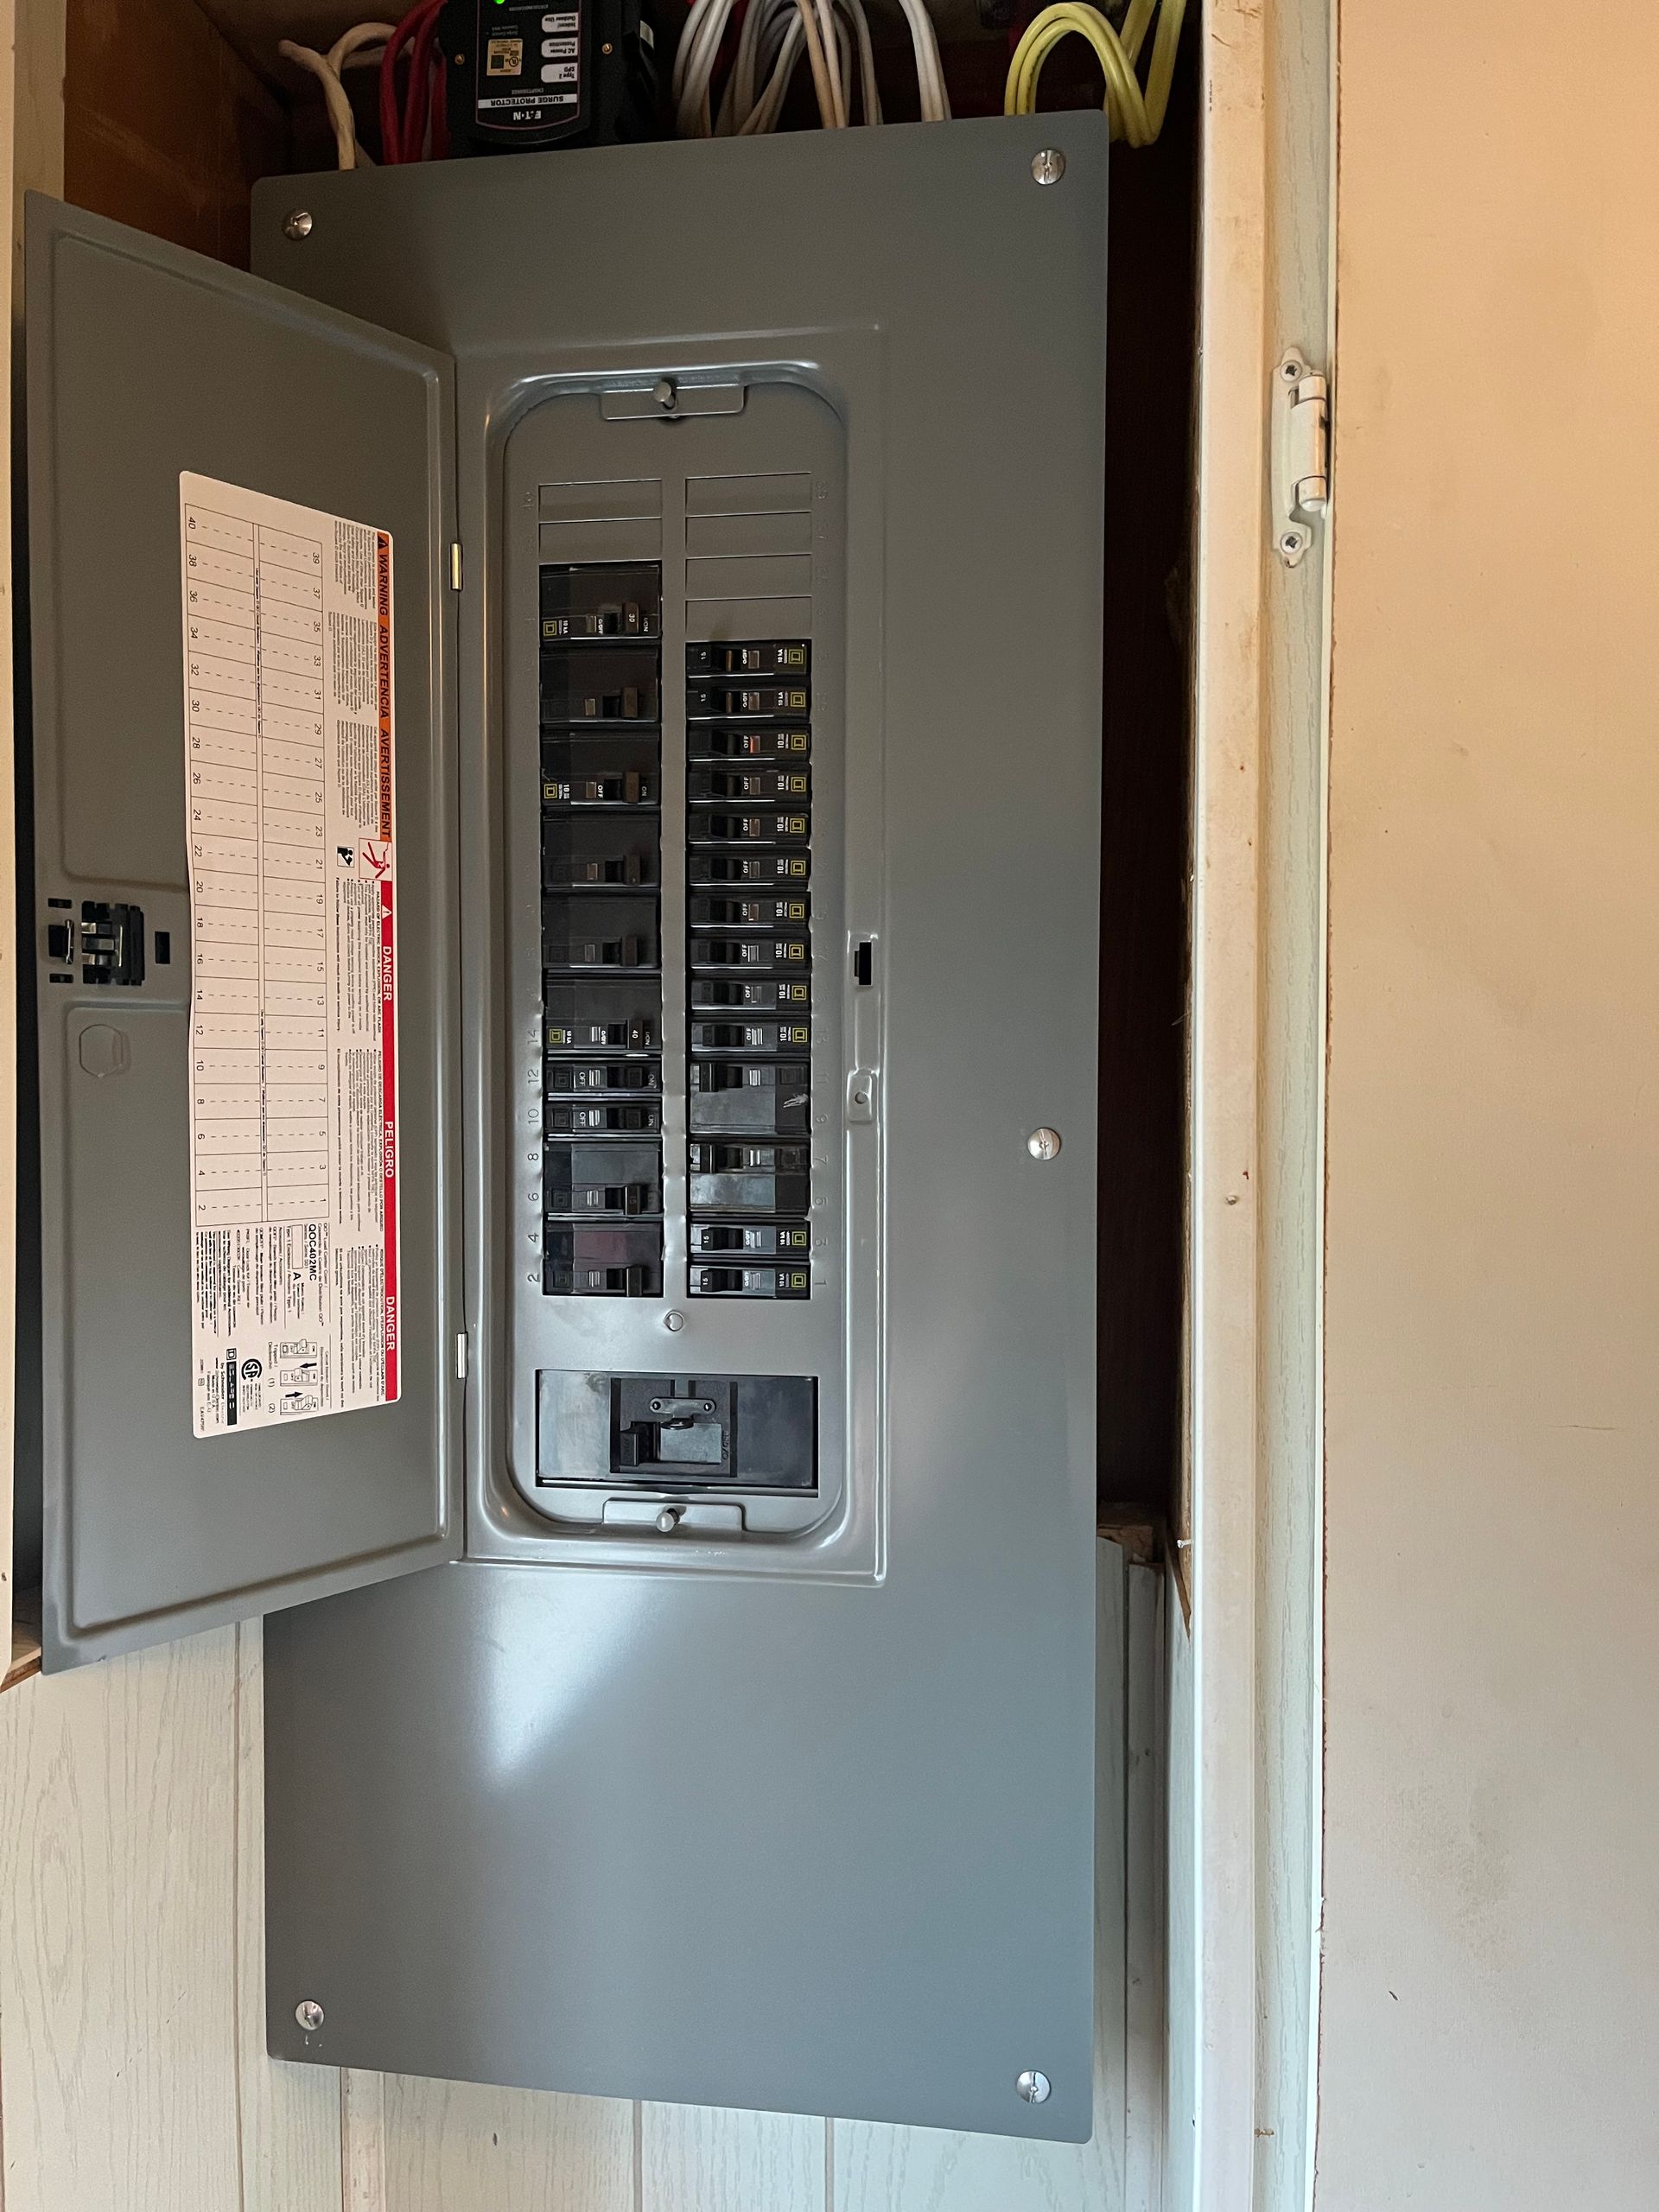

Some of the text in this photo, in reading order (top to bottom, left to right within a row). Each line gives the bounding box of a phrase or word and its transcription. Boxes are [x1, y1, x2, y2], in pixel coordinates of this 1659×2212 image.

[188, 517, 196, 529] 40
[188, 554, 197, 567] 38
[313, 552, 320, 564] 39
[378, 553, 389, 616] WARNING
[189, 590, 198, 602] 36
[313, 588, 320, 600] 37
[628, 613, 635, 623] 30
[314, 621, 321, 632] 35
[190, 627, 198, 639] 34
[314, 655, 321, 666] 33
[700, 652, 707, 660] 15
[191, 664, 199, 676] 32
[379, 625, 391, 719] ADVERTENCIA
[315, 690, 321, 700] 31
[700, 693, 707, 702] 15
[192, 700, 200, 712] 30
[315, 723, 321, 735] 29
[192, 737, 200, 749] 28
[777, 740, 785, 749] 10
[315, 758, 322, 769] 27
[193, 772, 200, 784] 26
[379, 728, 392, 838] AVERTISSEMENT
[563, 784, 570, 792] 10
[641, 786, 647, 797] ON
[777, 782, 785, 791] 10
[315, 791, 322, 803] 25
[194, 809, 201, 821] 24
[315, 826, 322, 837] 23
[776, 823, 784, 832] 10
[194, 845, 202, 857] 22
[315, 859, 323, 869] 21
[776, 866, 784, 874] 10
[196, 880, 203, 893] 20
[316, 894, 323, 904] 19
[775, 906, 783, 917] 10
[197, 918, 203, 928] 18
[317, 928, 324, 938] 17
[197, 954, 203, 964] 16
[775, 948, 783, 959] 10
[317, 963, 324, 972] 15
[382, 945, 392, 1001] DANGER
[197, 990, 203, 1000] 14
[778, 989, 785, 1000] 10
[317, 995, 324, 1006] 13
[196, 1025, 204, 1035] 12
[632, 1029, 639, 1039] 40
[779, 1032, 787, 1042] 10
[196, 1060, 204, 1071] 10
[527, 1068, 539, 1085] 12
[648, 1073, 656, 1086] ON
[527, 1108, 540, 1125] 10
[648, 1114, 654, 1127] ON
[385, 1121, 394, 1179] PELIGRO
[527, 1192, 540, 1201] 6
[527, 1233, 539, 1242] 4
[702, 1236, 709, 1244] 15
[815, 1237, 829, 1248] 3
[308, 1224, 317, 1281] QOC402MC
[293, 1272, 302, 1281] A
[527, 1274, 540, 1282] 2
[702, 1277, 709, 1286] 15
[385, 1296, 396, 1351] DANGER
[267, 1377, 276, 1388] (1)
